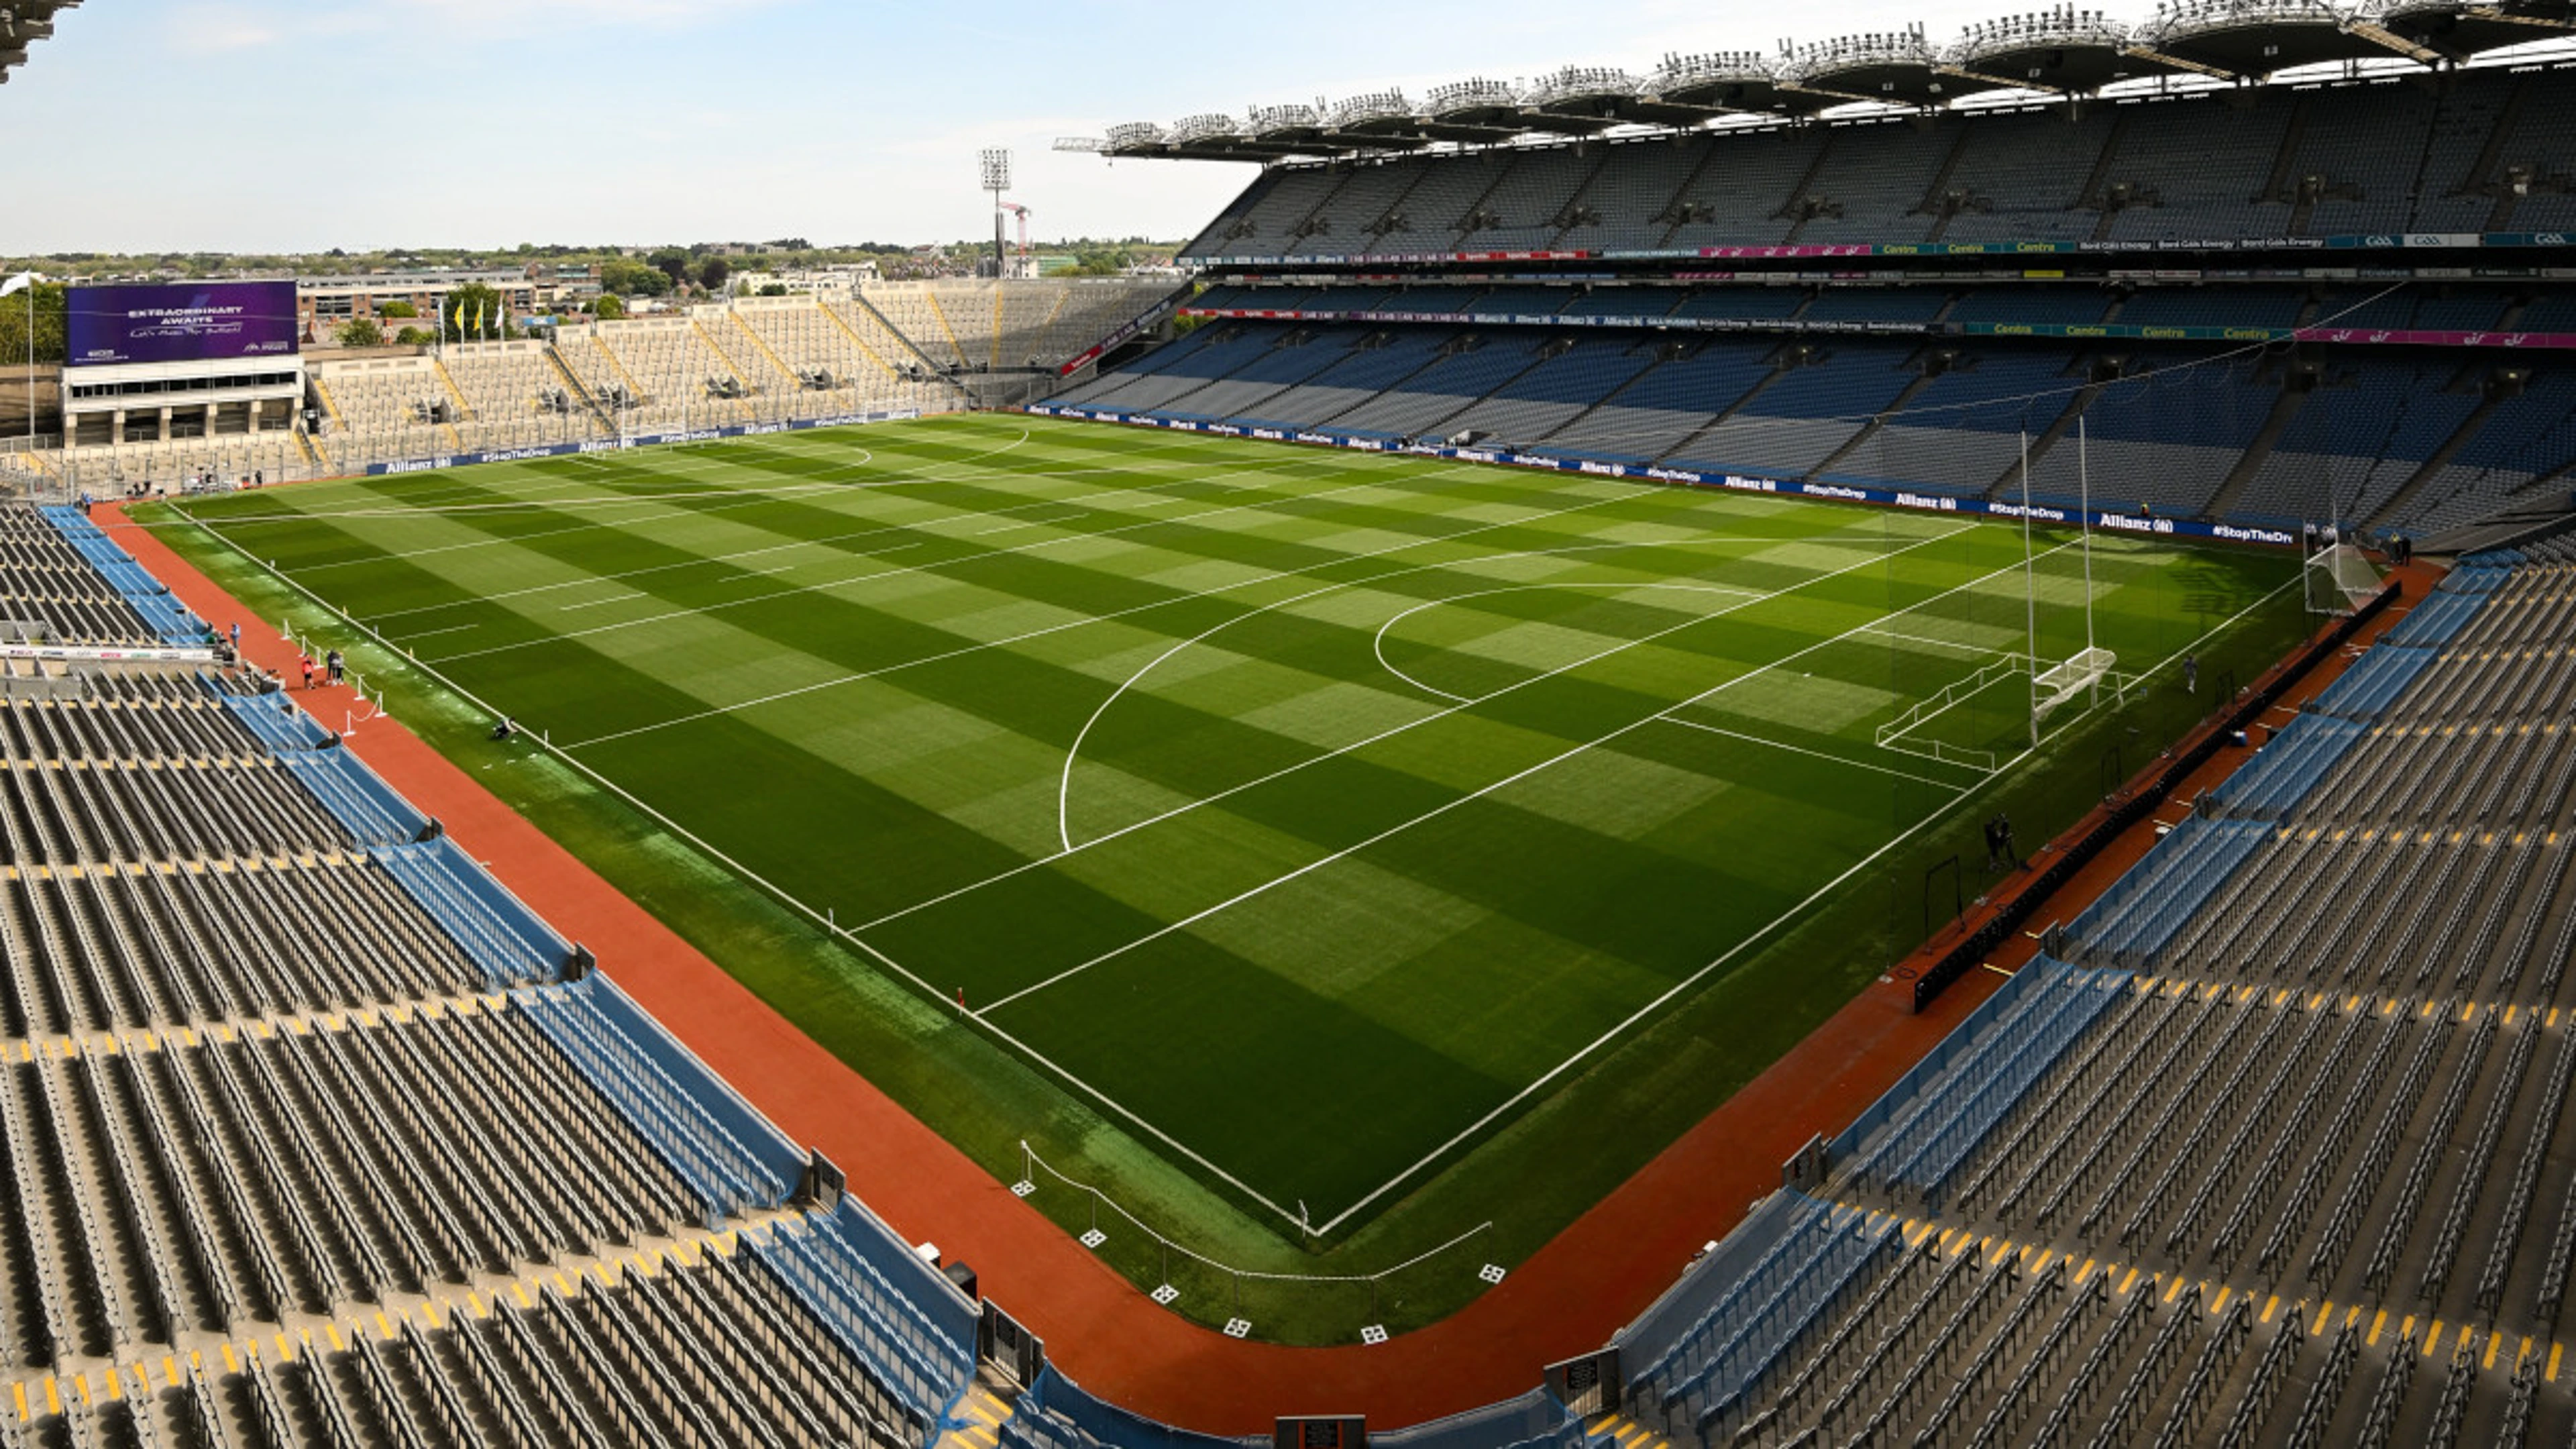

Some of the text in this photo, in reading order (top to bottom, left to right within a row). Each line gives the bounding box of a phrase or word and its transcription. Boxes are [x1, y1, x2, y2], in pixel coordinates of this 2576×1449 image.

[1883, 244, 1918, 254] Centra
[1947, 242, 1984, 253] Centra
[2017, 241, 2055, 252] Centra
[128, 307, 244, 318] EXTRAORDINARY
[160, 316, 213, 325] AWAITS
[1994, 323, 2032, 334] Centra
[2066, 325, 2106, 335] Centra
[2142, 327, 2185, 338] Centra
[2224, 327, 2269, 339] Centra
[580, 440, 619, 452] Allianz
[482, 447, 551, 462] #StopTheDrop
[386, 460, 432, 474] Allianz
[1725, 476, 1761, 489] Allianz
[1803, 484, 1866, 500] #StopTheDrop
[1895, 493, 1938, 509] Allianz
[1989, 503, 2064, 520] #StopTheDrop
[2100, 513, 2151, 531] Allianz
